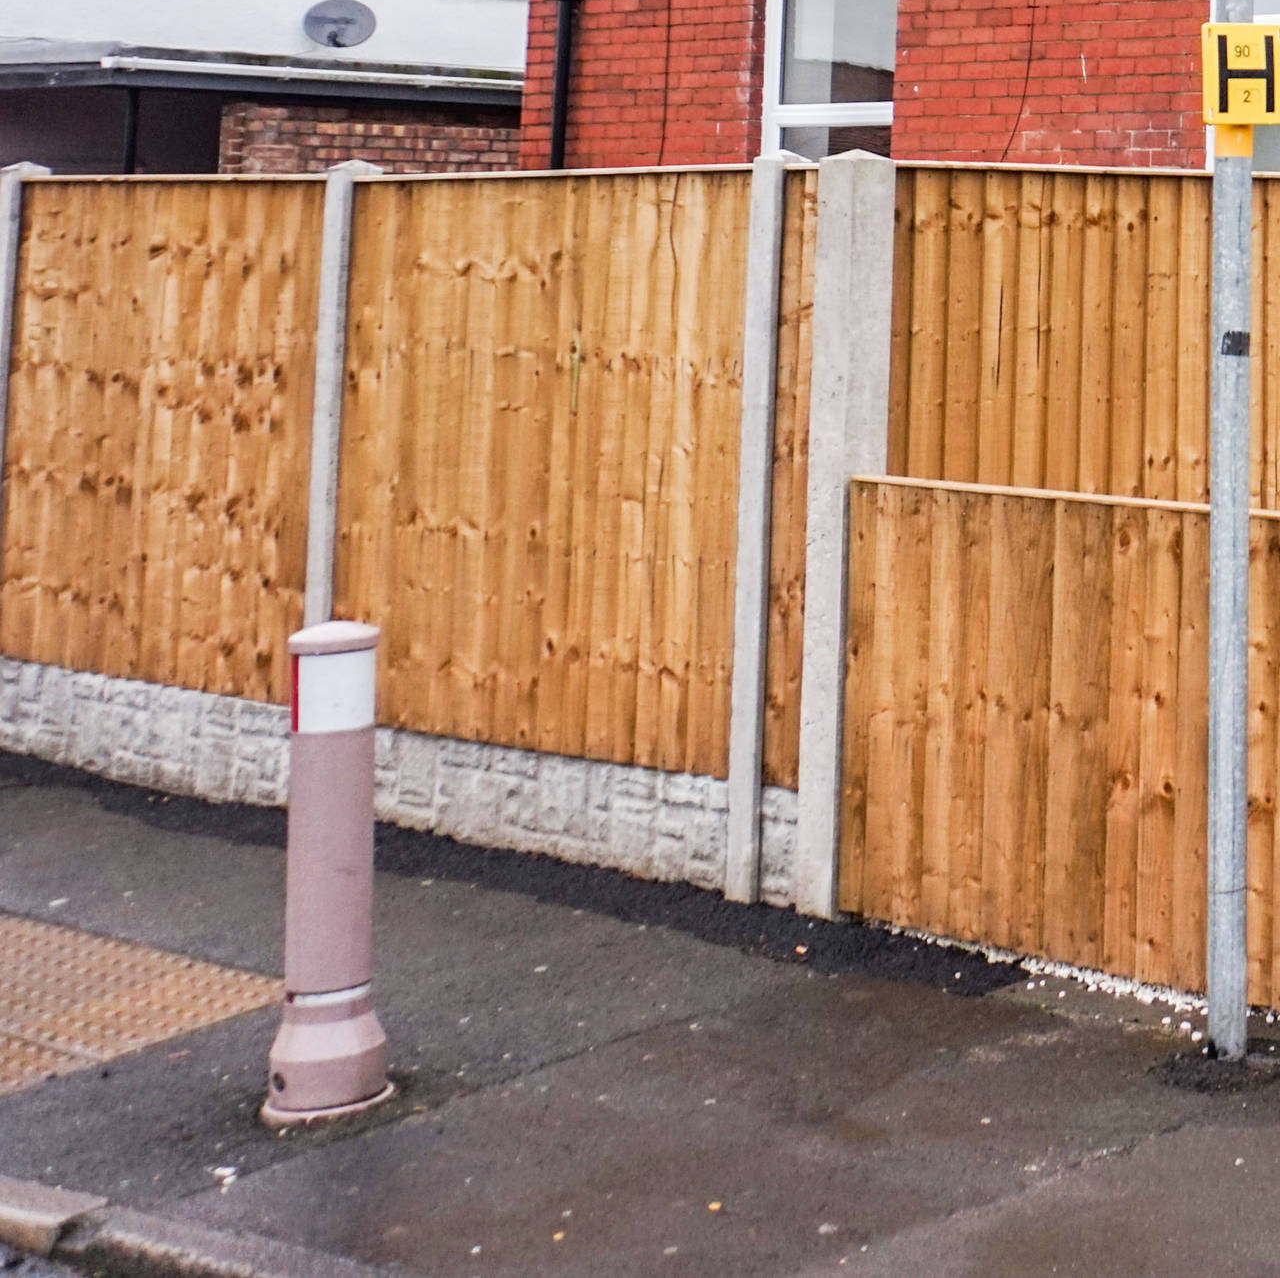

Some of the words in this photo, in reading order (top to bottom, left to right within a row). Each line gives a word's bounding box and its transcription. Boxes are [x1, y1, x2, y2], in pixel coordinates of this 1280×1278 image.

[1234, 44, 1251, 58] 90
[1217, 34, 1275, 113] H
[1243, 90, 1251, 103] 2
